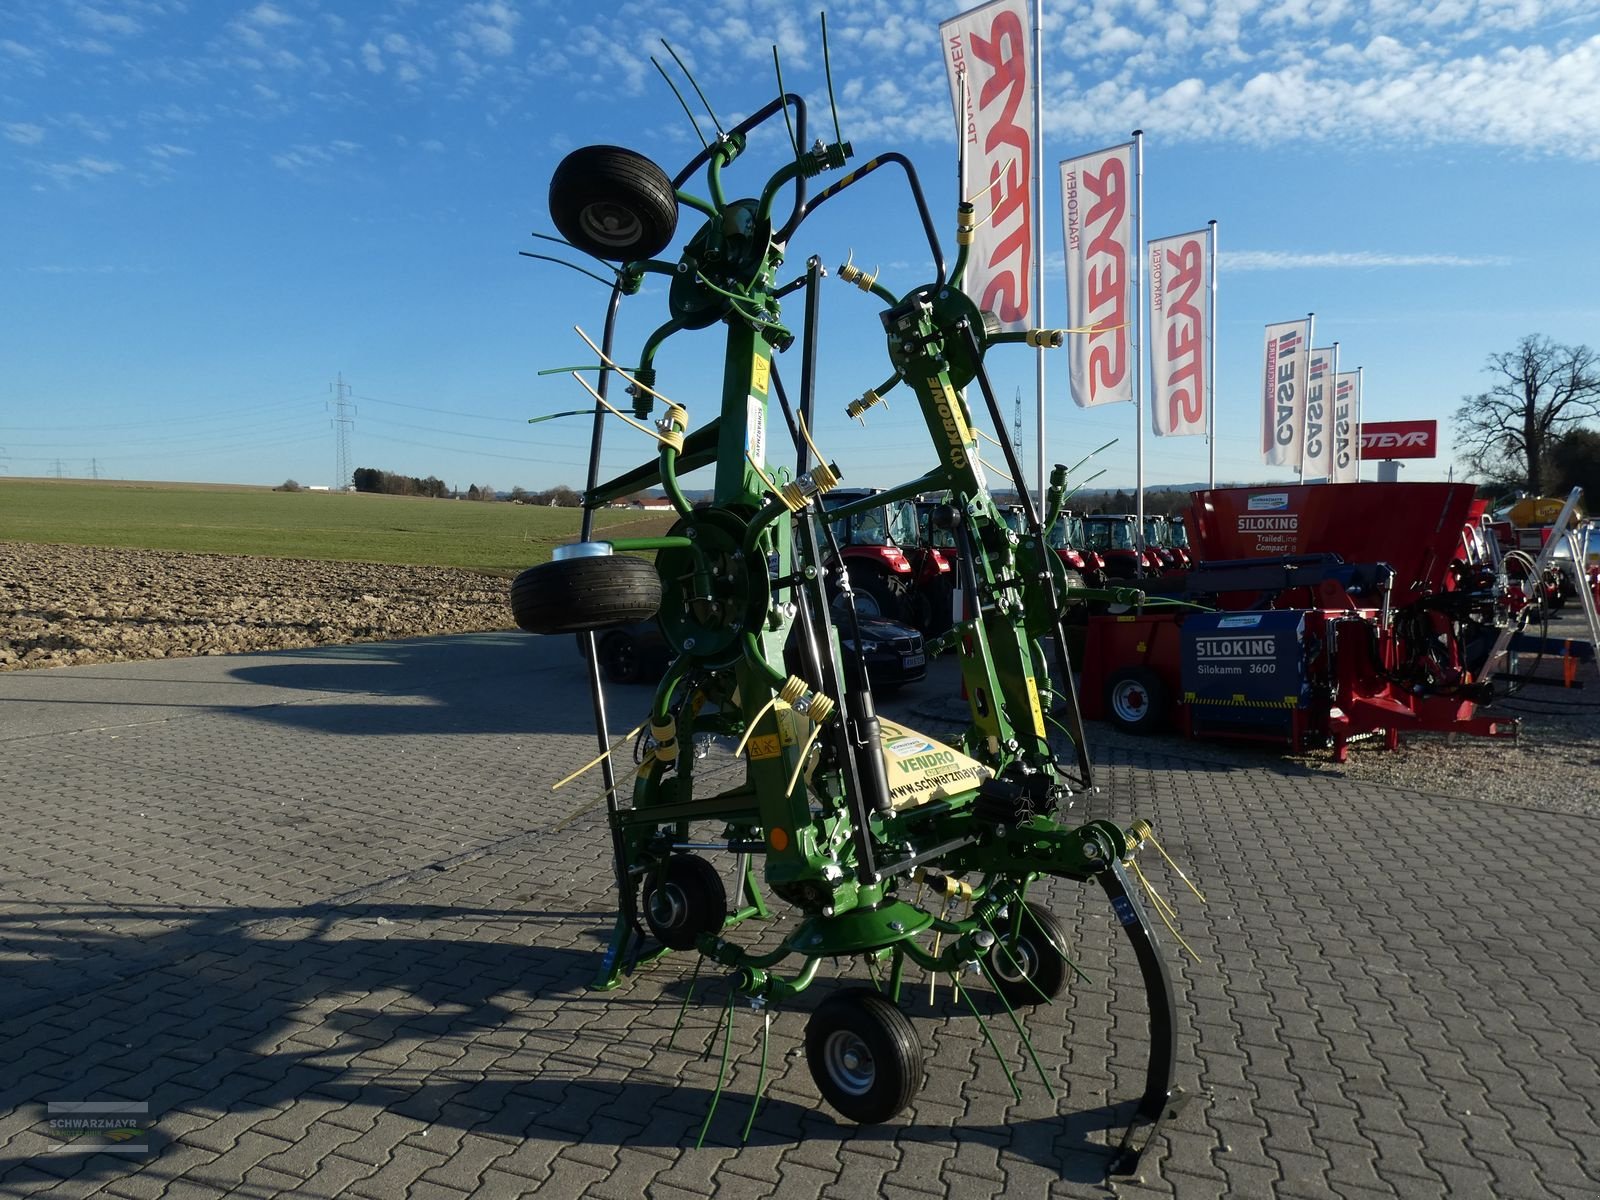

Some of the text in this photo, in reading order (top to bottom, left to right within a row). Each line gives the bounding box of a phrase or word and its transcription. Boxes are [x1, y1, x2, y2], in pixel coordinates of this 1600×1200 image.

[926, 376, 963, 446] KRONE
[1238, 518, 1298, 530] SILOKING
[1255, 543, 1288, 553] Compact
[1196, 640, 1276, 656] SILOKING
[1198, 663, 1276, 674] Silokamm 3600
[896, 750, 955, 773] VENDRO
